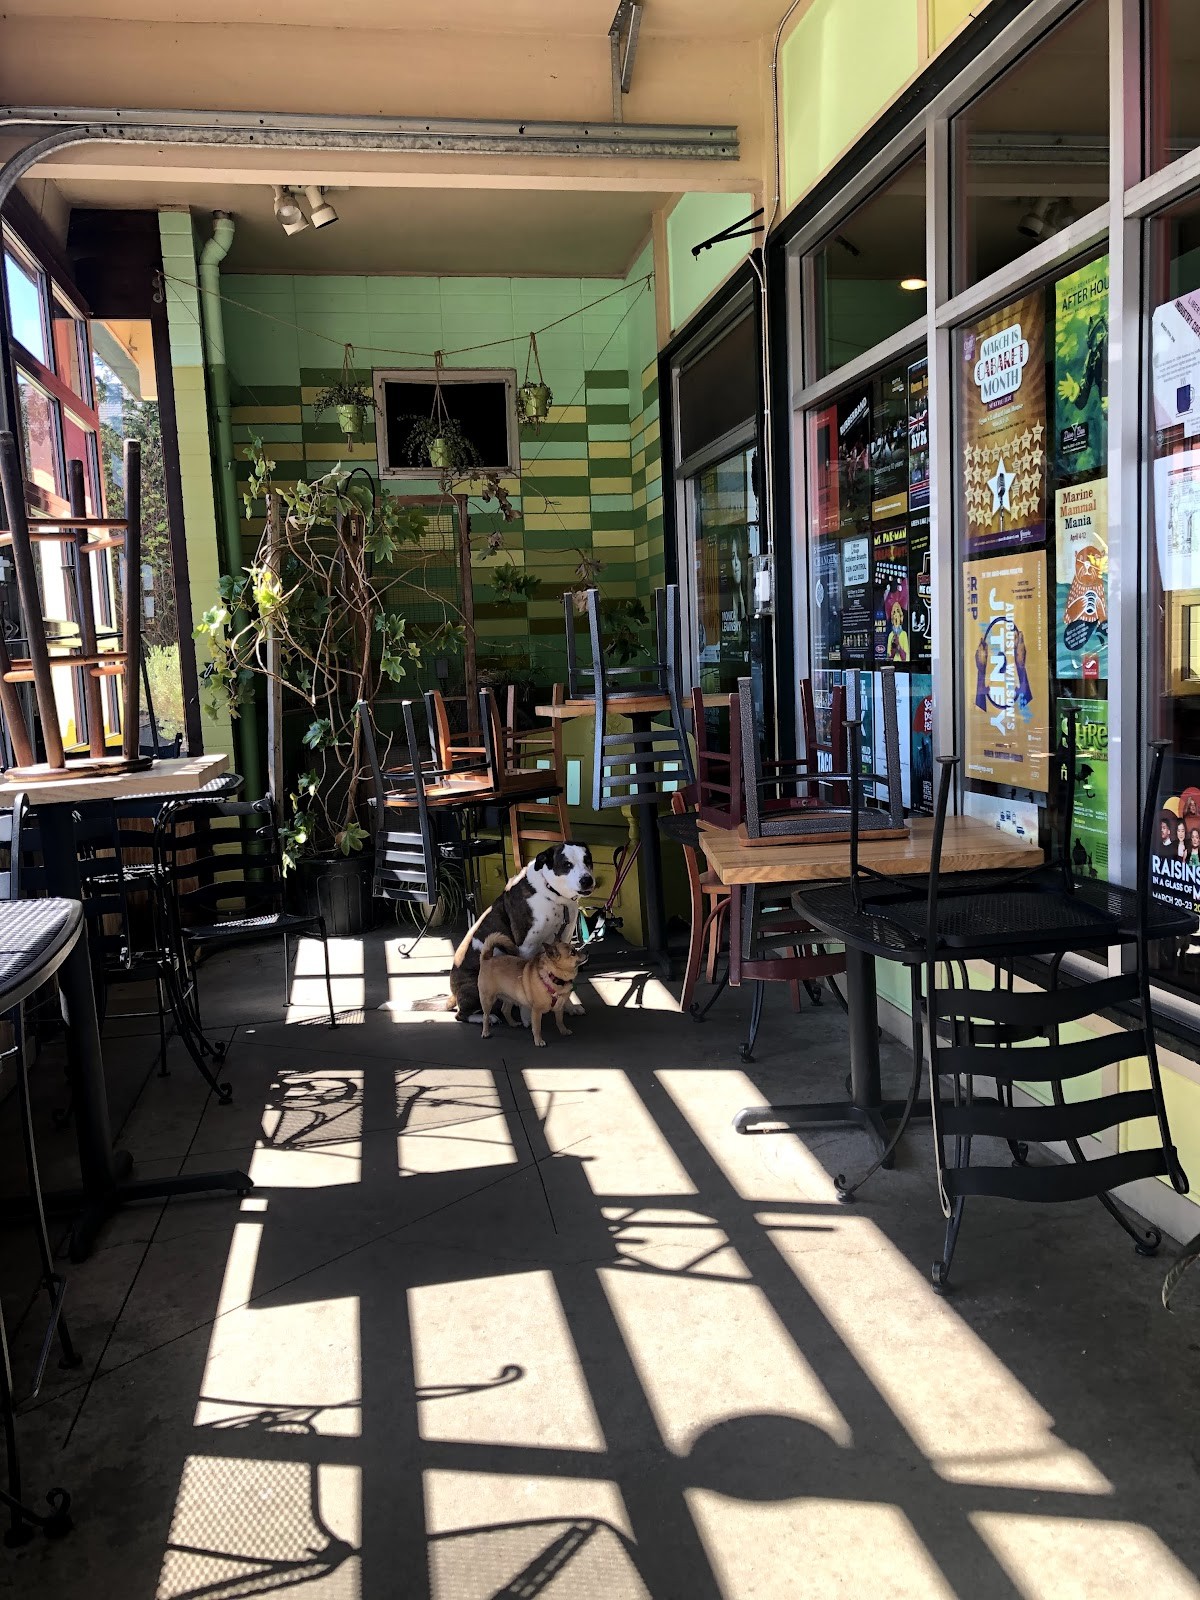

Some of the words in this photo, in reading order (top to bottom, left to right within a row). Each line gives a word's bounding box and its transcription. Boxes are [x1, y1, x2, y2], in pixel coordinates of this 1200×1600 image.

[1062, 287, 1088, 312] AFTER
[982, 332, 1010, 357] MARCH
[1011, 329, 1019, 343] IS
[976, 343, 1026, 381] CABARET
[982, 368, 1019, 397] MONTH
[1060, 499, 1097, 518] Mammal
[1062, 489, 1094, 504] Marine
[1064, 515, 1092, 530] Mania
[1070, 532, 1079, 542] April
[970, 576, 978, 620] REP
[1005, 602, 1015, 656] AUGUST
[989, 587, 1006, 736] JITNEY
[1005, 663, 1016, 730] WILSON'S
[817, 750, 833, 773] TACO
[1152, 854, 1200, 886] RAISINS
[1152, 876, 1159, 885] IN
[1159, 878, 1165, 887] A
[1165, 880, 1184, 892] GLASS
[1184, 884, 1193, 894] OF
[1152, 891, 1174, 905] MARCH
[1174, 897, 1193, 910] 20-23
